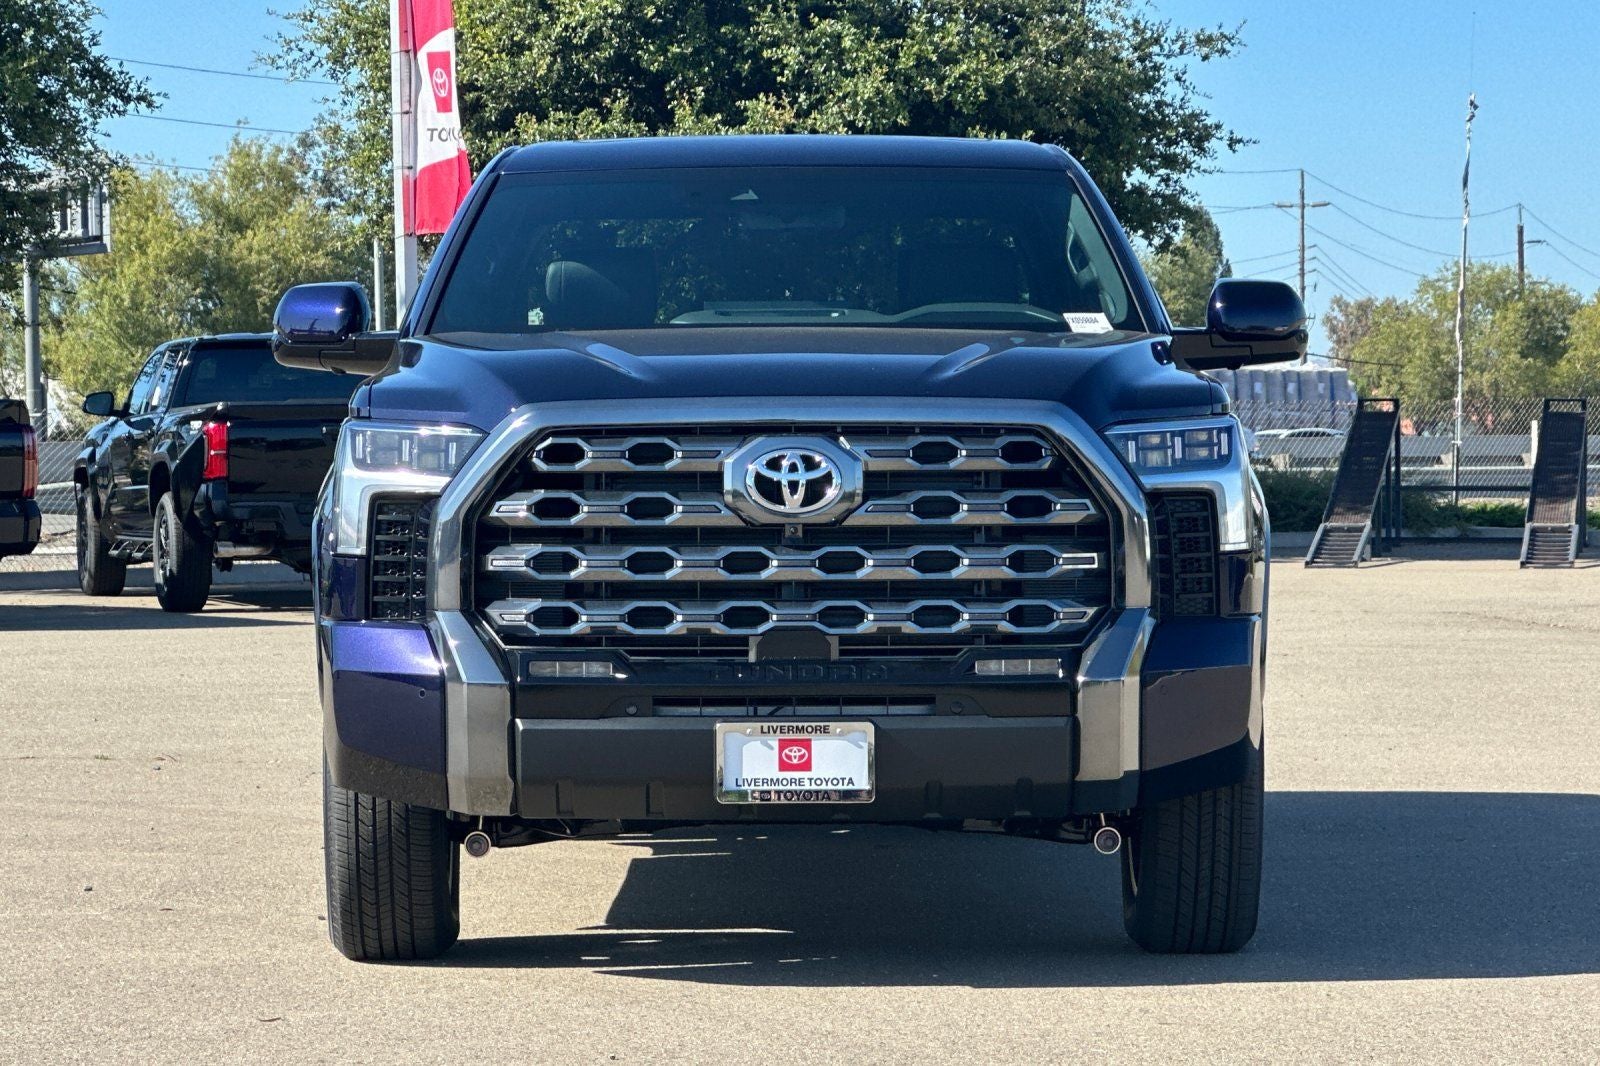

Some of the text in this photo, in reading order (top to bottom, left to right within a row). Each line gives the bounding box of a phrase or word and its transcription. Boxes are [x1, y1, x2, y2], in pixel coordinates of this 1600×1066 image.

[760, 724, 831, 735] LIVERMORE
[735, 777, 855, 787] LIVERMORE TOYOTA
[776, 790, 831, 801] TOYOTA
